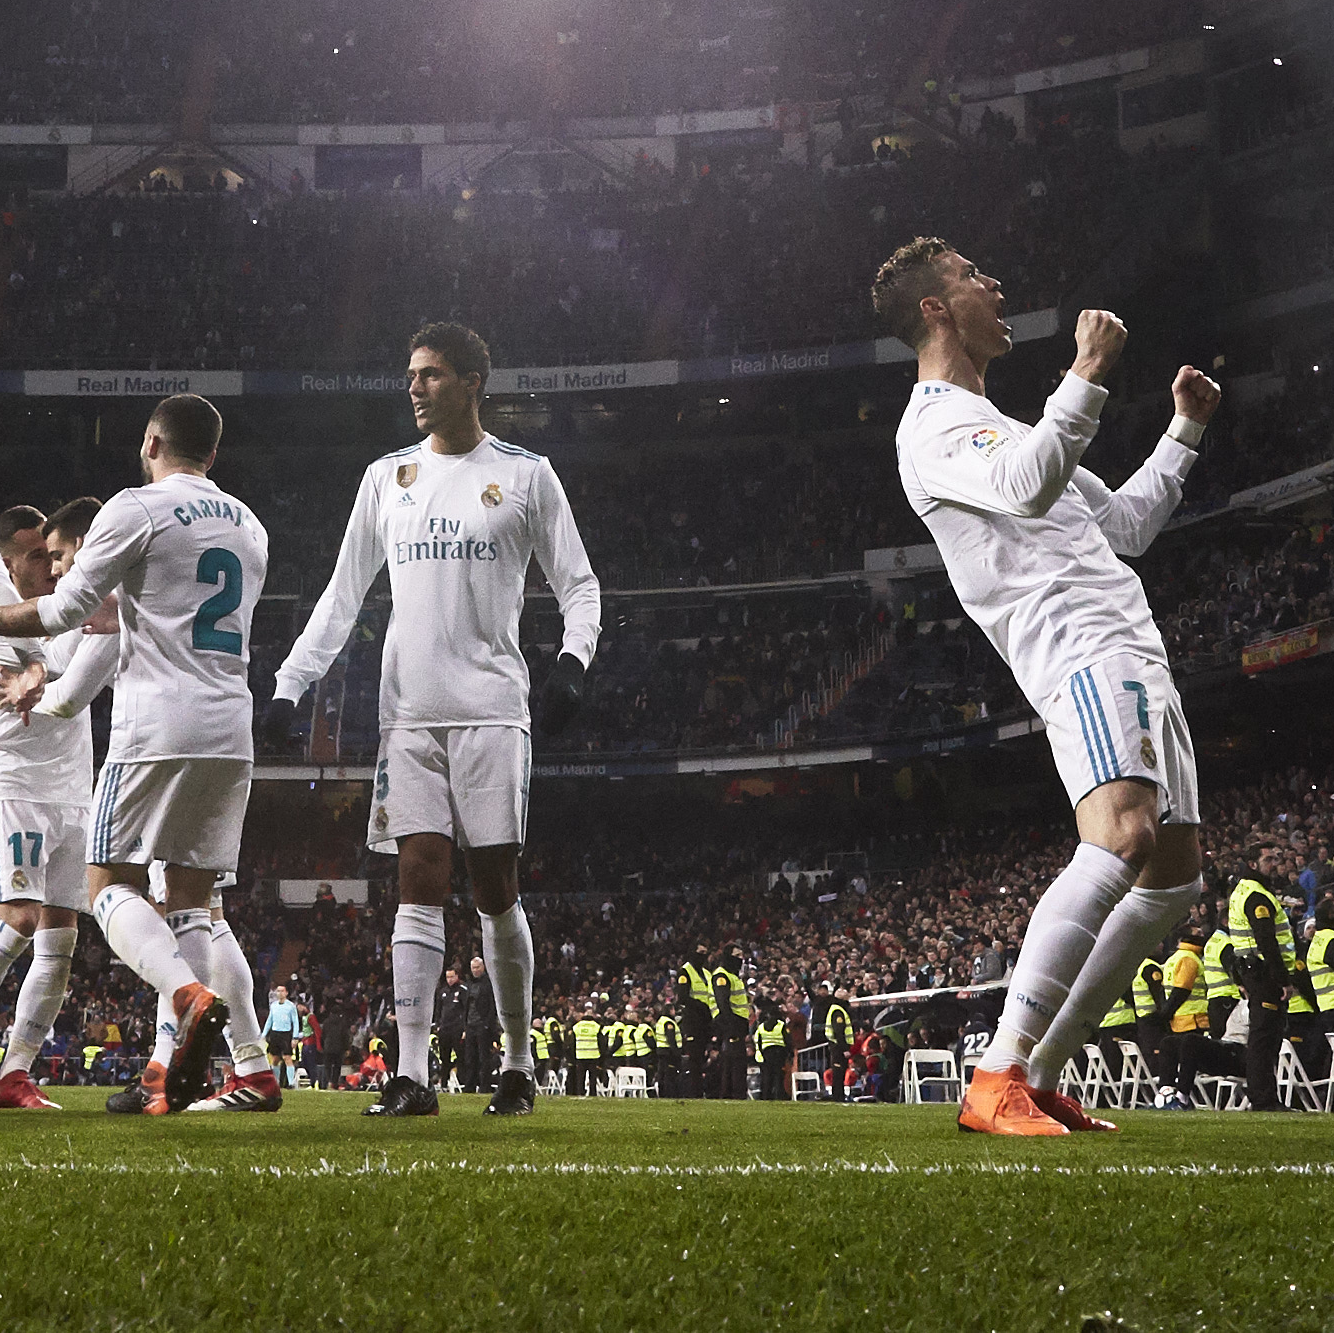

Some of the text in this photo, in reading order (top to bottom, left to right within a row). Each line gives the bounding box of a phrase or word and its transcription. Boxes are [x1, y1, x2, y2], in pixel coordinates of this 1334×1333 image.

[731, 351, 830, 376] Real Madrid
[77, 376, 190, 393] Real Madrid
[301, 374, 340, 391] Real
[517, 369, 627, 390] Real Madrid
[429, 517, 461, 536] Fly
[395, 535, 497, 565] Emirates
[192, 547, 244, 656] 2
[1122, 680, 1150, 730] 7
[376, 758, 389, 802] 5
[8, 831, 43, 867] 17
[395, 997, 420, 1007] MCF
[963, 1031, 990, 1056] 22
